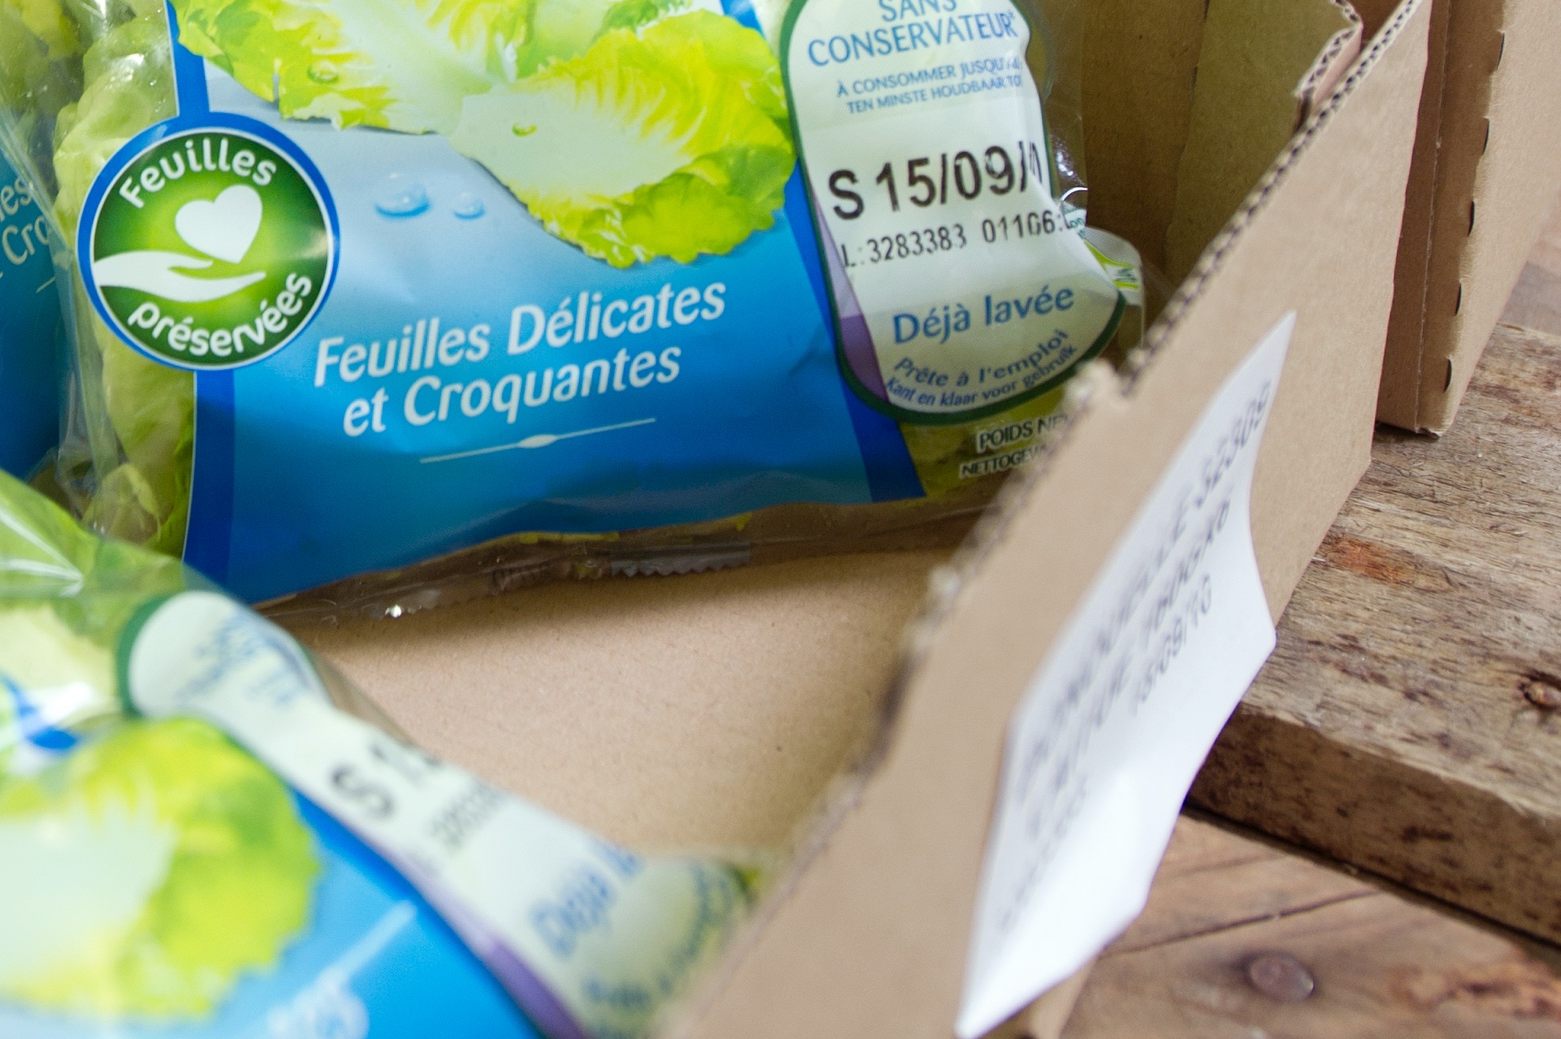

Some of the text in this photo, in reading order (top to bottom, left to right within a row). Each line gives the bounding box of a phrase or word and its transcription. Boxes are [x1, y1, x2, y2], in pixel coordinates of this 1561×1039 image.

[852, 65, 957, 94] CONSOMMER
[119, 137, 277, 209] Feuilles
[828, 169, 865, 220] S
[127, 272, 312, 357] préservées
[314, 281, 727, 388] Feuilles Délicates
[893, 284, 1075, 345] Déjà lavée
[894, 328, 1070, 388] Prête à l'emploi
[342, 345, 682, 437] et Croquantes
[917, 392, 936, 406] en
[981, 380, 1018, 401] voor
[978, 420, 1034, 452] POIDS
